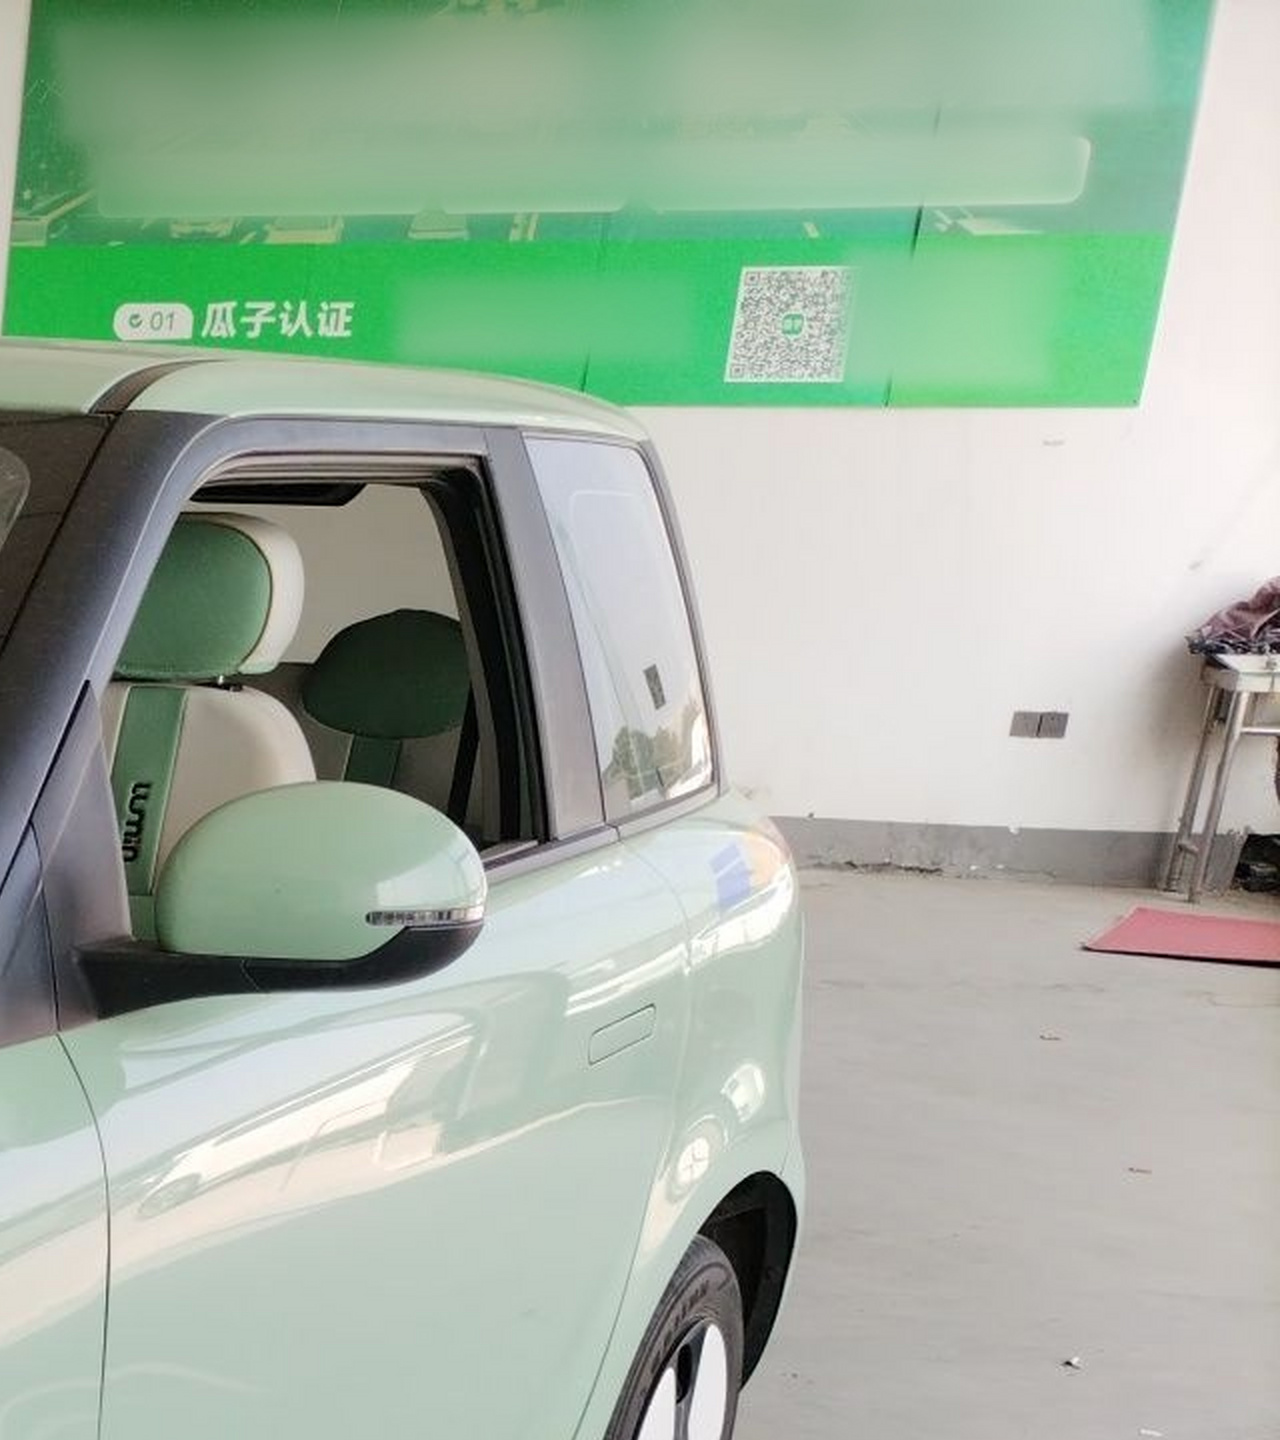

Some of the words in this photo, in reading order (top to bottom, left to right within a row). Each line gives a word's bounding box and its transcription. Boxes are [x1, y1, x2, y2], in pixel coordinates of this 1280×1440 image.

[149, 310, 176, 332] 01
[200, 300, 356, 339] 瓜子认证
